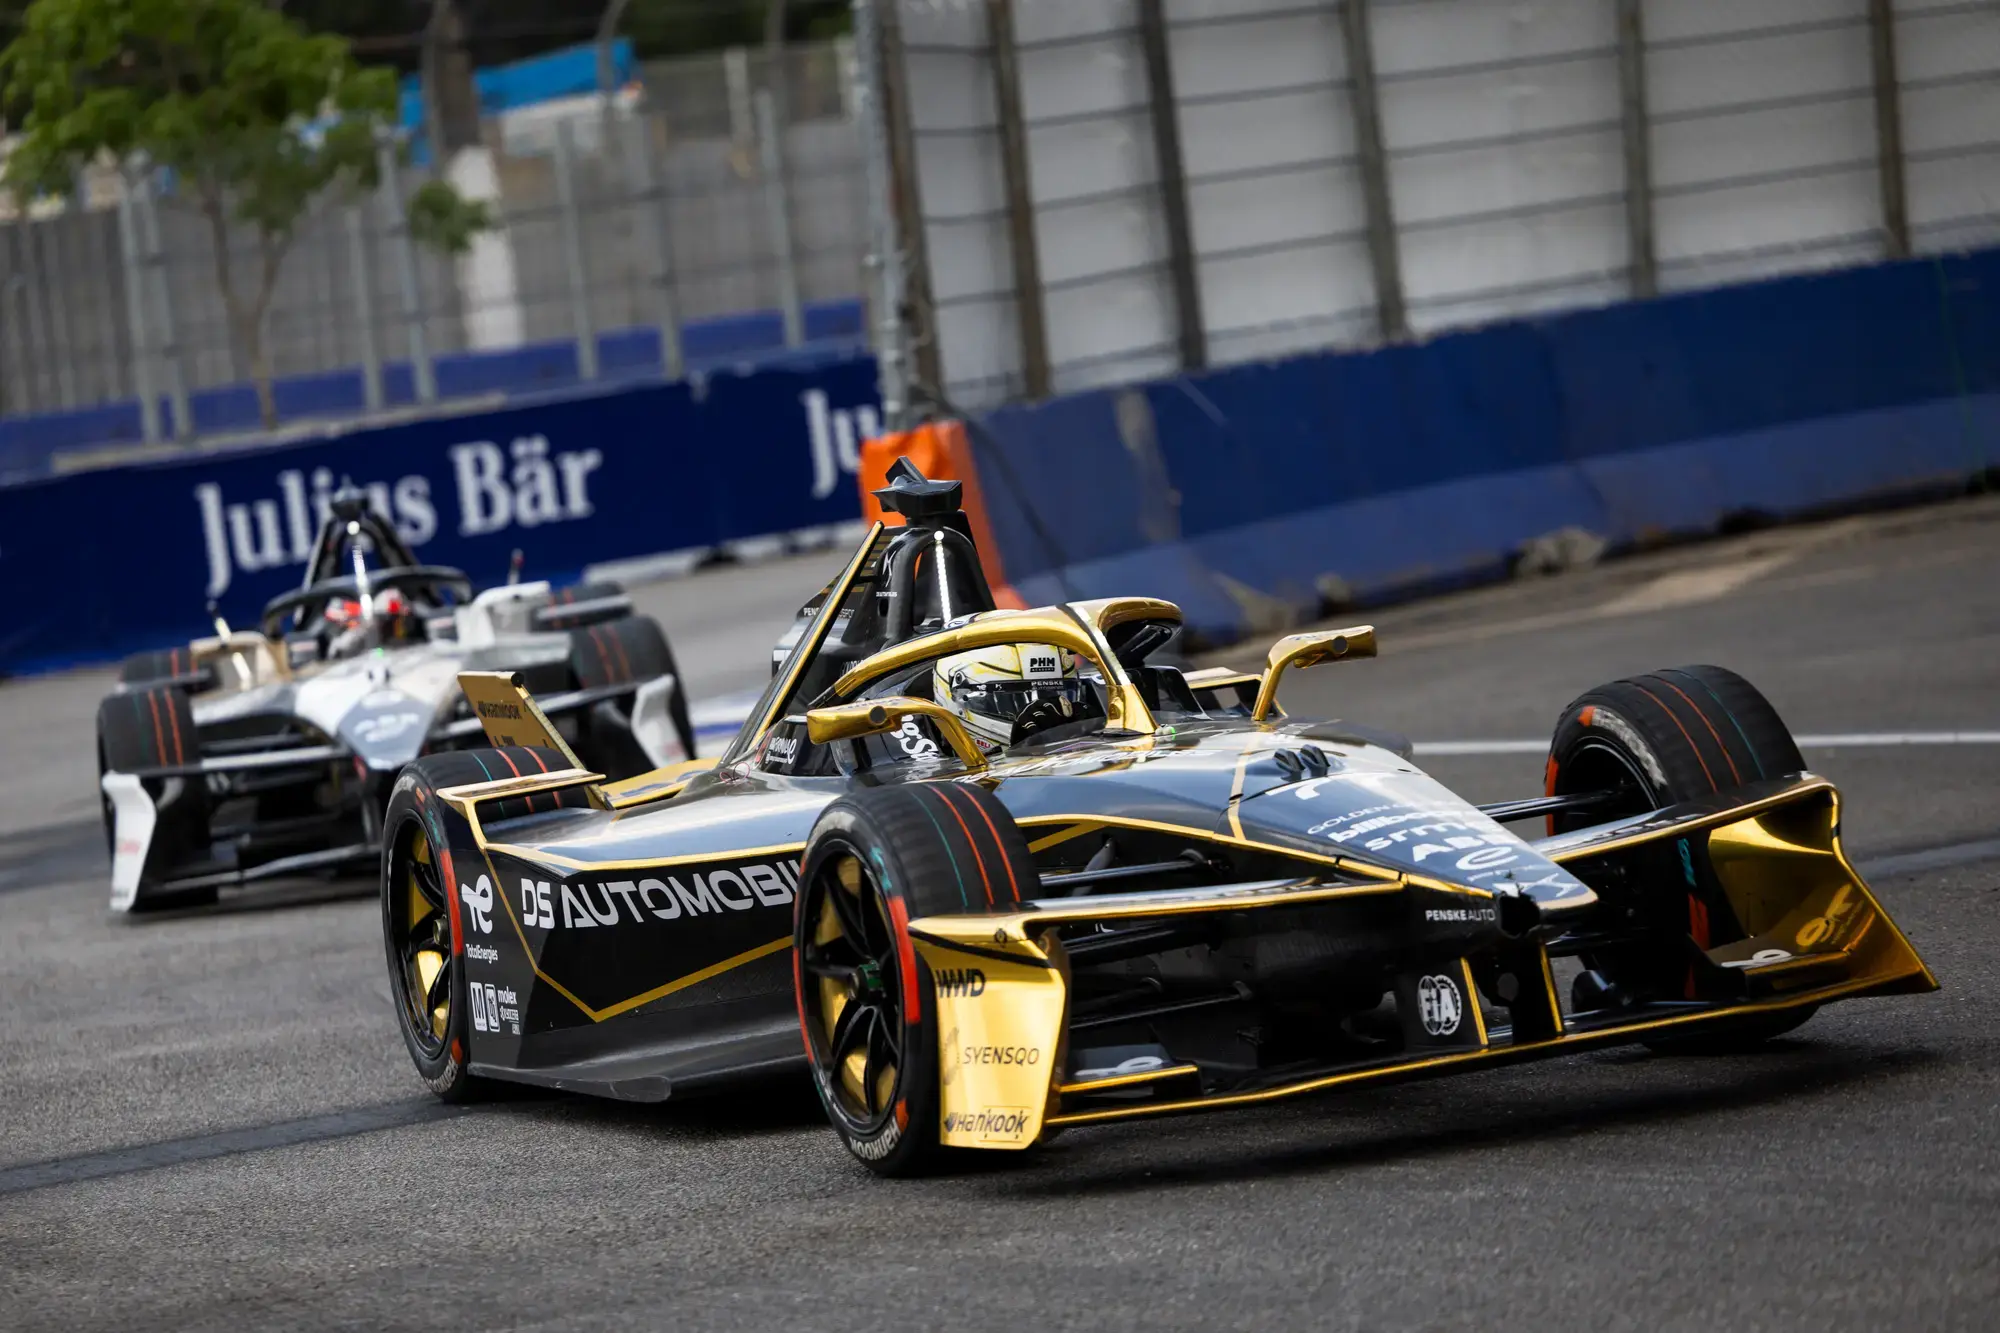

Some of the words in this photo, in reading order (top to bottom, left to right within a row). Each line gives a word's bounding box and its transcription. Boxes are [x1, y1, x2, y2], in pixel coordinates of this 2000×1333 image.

[448, 434, 602, 536] Bär
[1030, 657, 1055, 668] PHM
[1306, 804, 1391, 835] GOLDEN
[521, 878, 555, 929] DS
[1425, 909, 1468, 922] PENSKE
[1468, 908, 1497, 921] AUTO
[465, 943, 499, 964] TotalEnergies
[497, 985, 518, 1005] molex
[936, 967, 987, 999] WWD
[1420, 987, 1458, 1023] FIA
[963, 1046, 1041, 1068] SYENSQO
